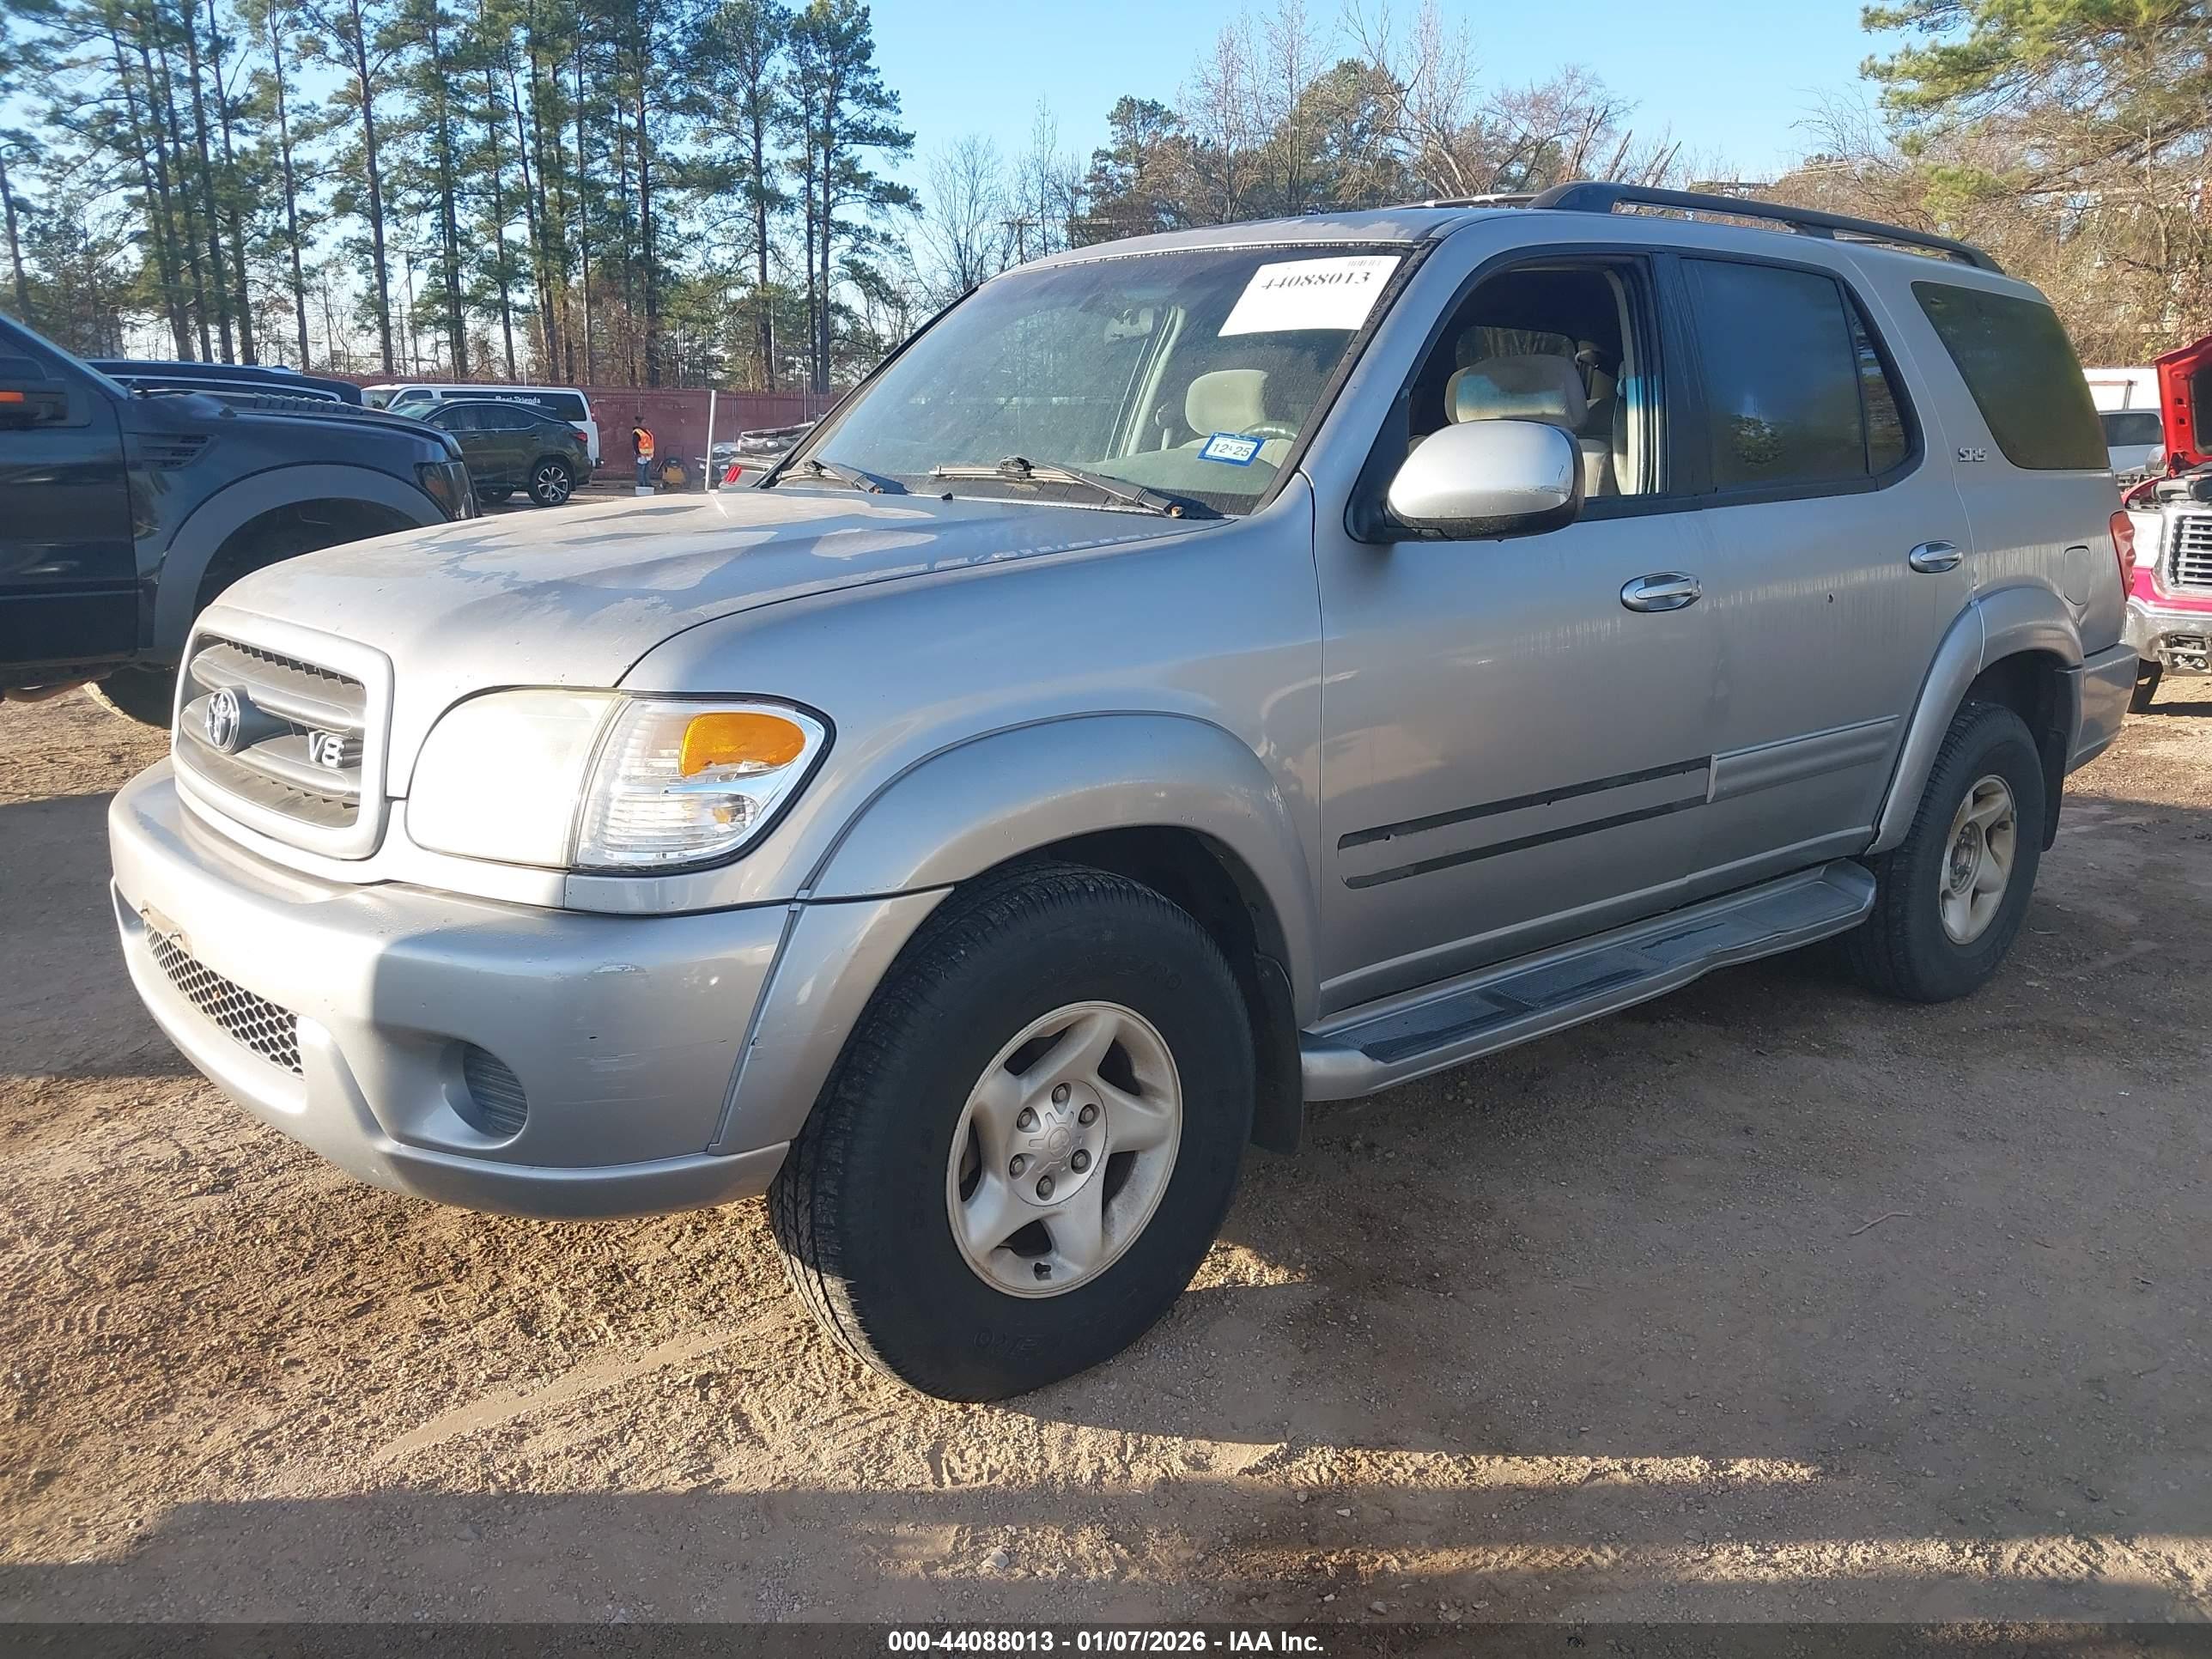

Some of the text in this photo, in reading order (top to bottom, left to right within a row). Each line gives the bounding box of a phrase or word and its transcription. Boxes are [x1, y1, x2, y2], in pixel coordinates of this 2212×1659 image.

[1261, 270, 1372, 289] 44088013
[1957, 447, 1986, 462] SR5
[308, 729, 346, 769] V8
